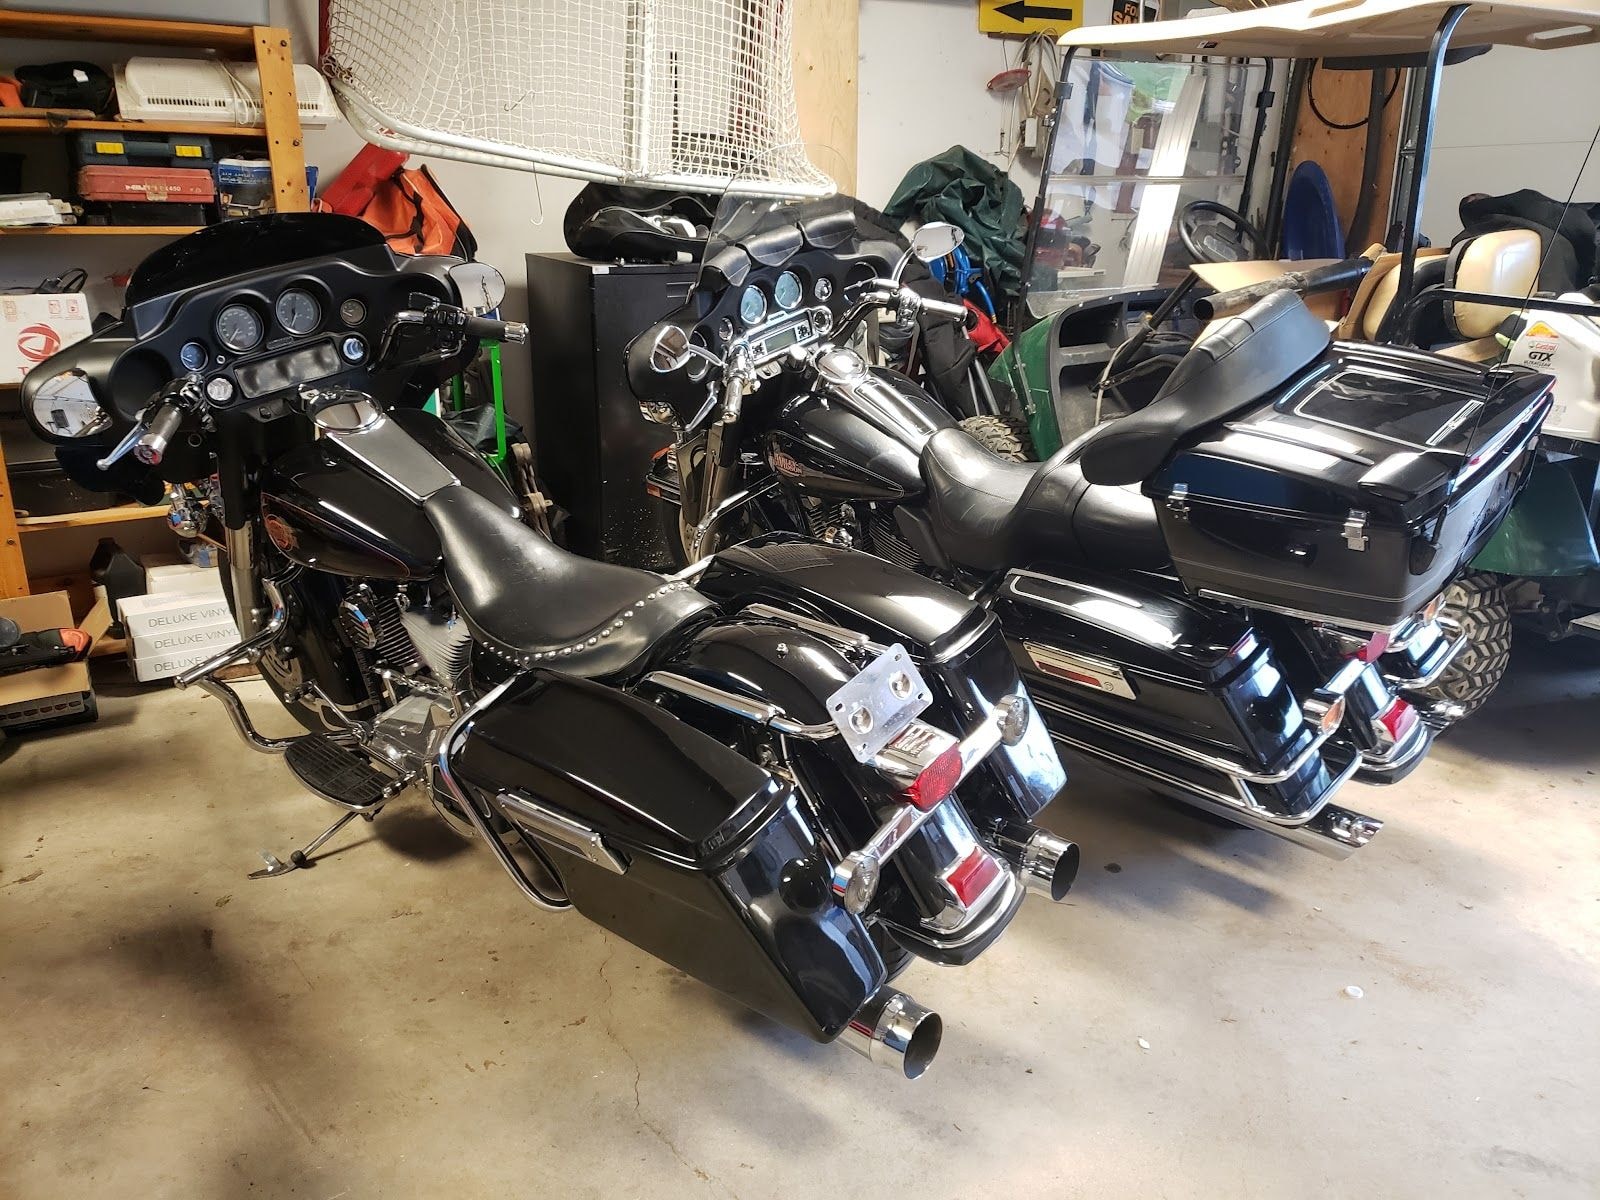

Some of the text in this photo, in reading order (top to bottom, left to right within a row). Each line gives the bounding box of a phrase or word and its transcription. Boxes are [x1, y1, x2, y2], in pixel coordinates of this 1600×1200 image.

[1528, 351, 1554, 361] GTX
[148, 606, 228, 628] DELUXE VINY
[154, 628, 240, 649] DELUXE VINYL
[154, 656, 203, 673] DELUXE
